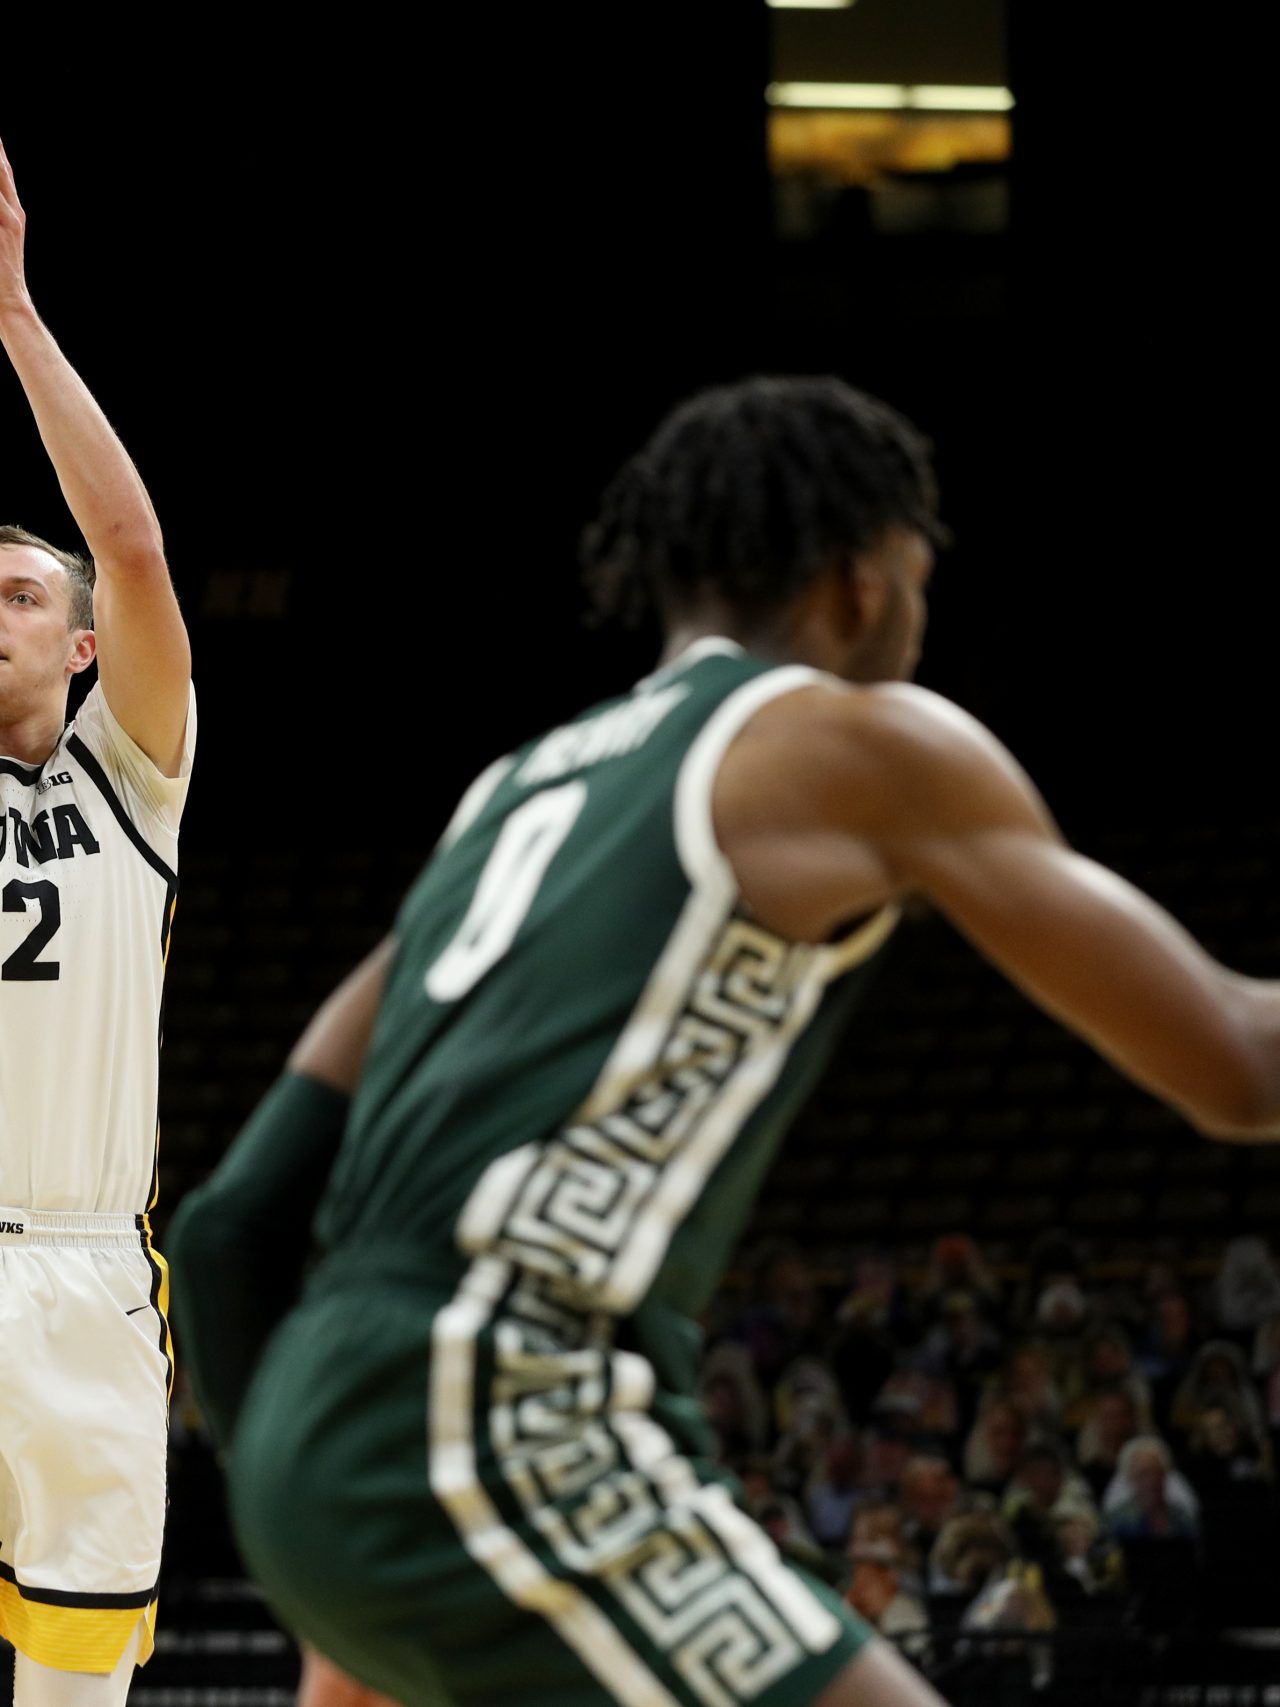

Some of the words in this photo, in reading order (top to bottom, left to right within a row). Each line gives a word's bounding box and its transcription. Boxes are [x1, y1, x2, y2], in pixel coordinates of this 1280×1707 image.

[35, 771, 73, 795] BIG
[1, 878, 61, 980] 2
[423, 779, 588, 1004] 0
